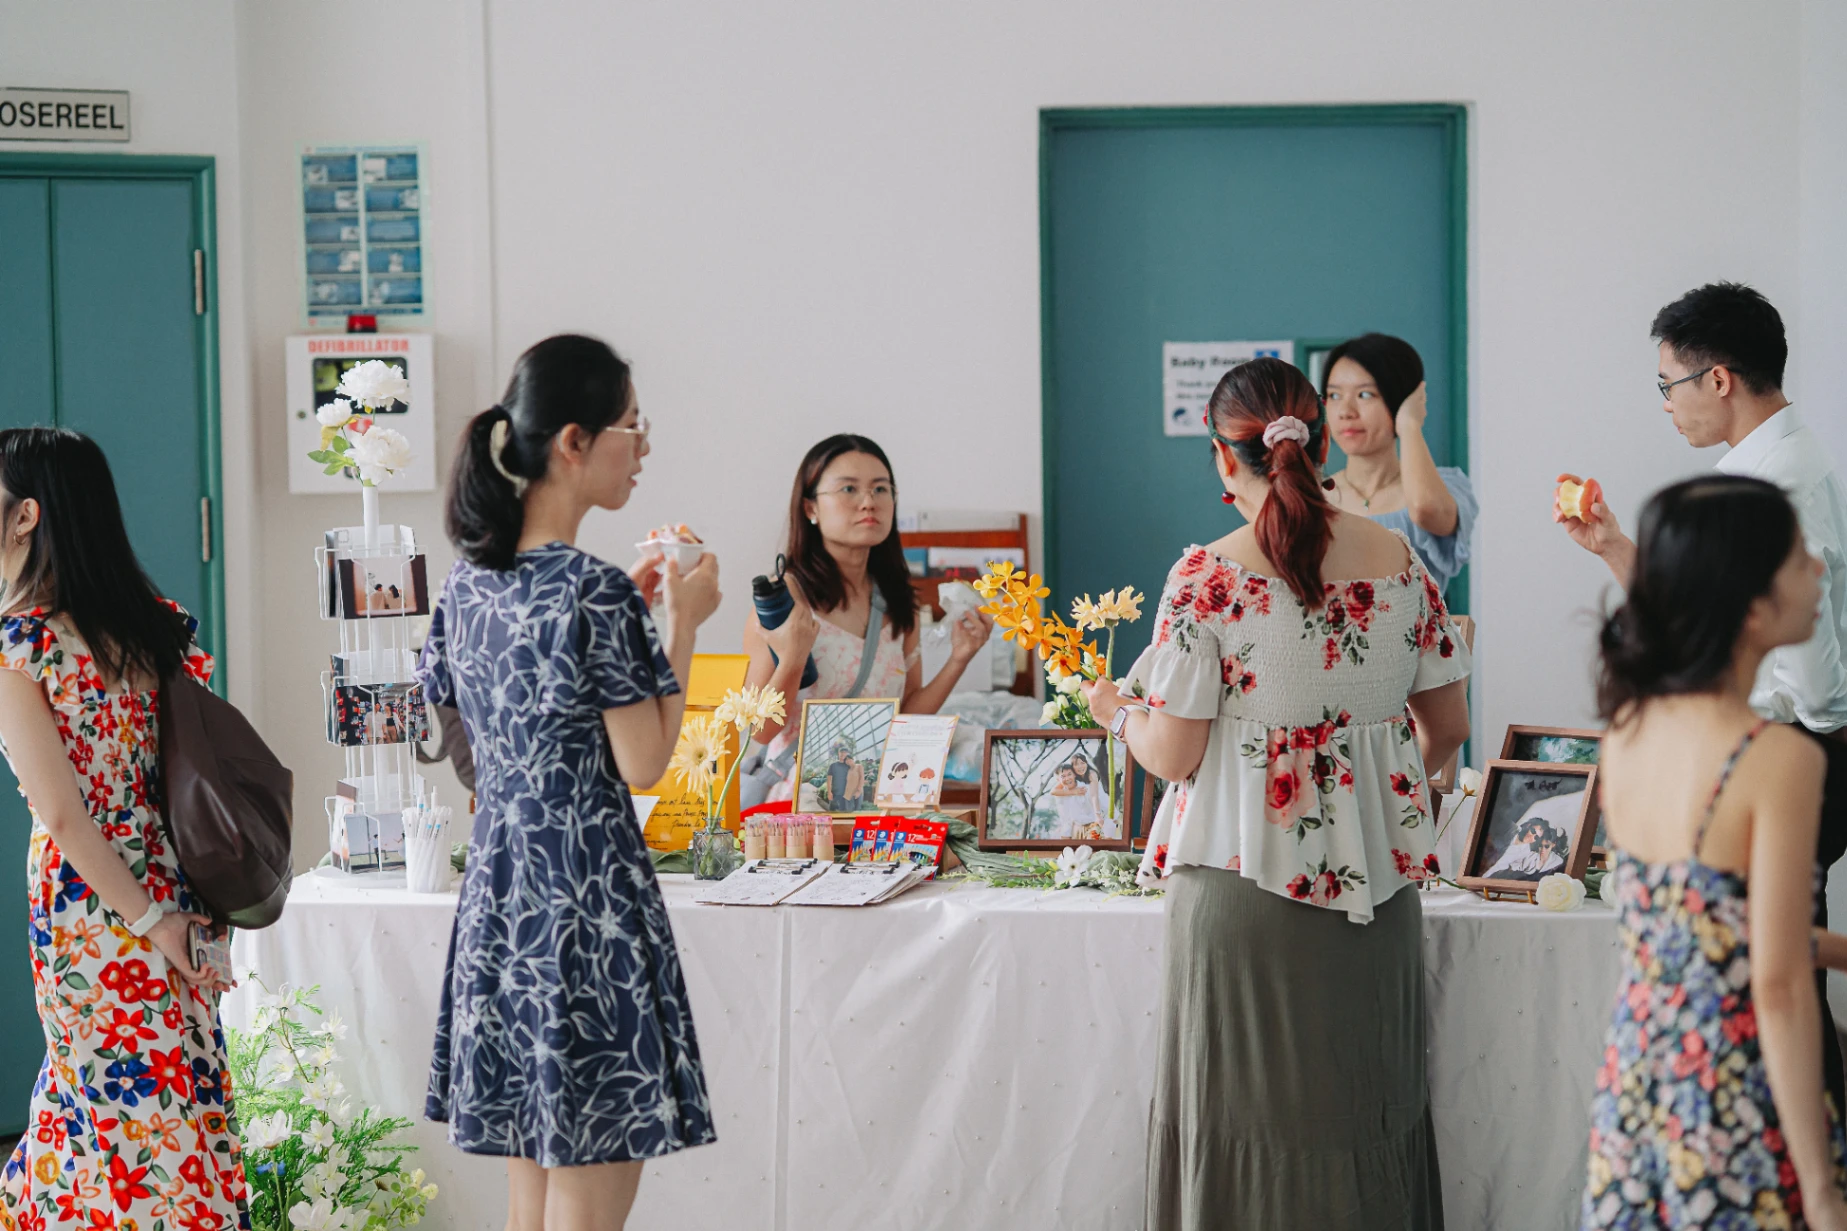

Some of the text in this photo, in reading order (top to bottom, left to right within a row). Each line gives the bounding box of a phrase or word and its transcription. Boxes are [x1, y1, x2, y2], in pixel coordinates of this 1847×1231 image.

[0, 101, 125, 129] OSEREEL
[308, 339, 409, 353] DEFIBRILLATOR
[1171, 356, 1205, 370] Baby
